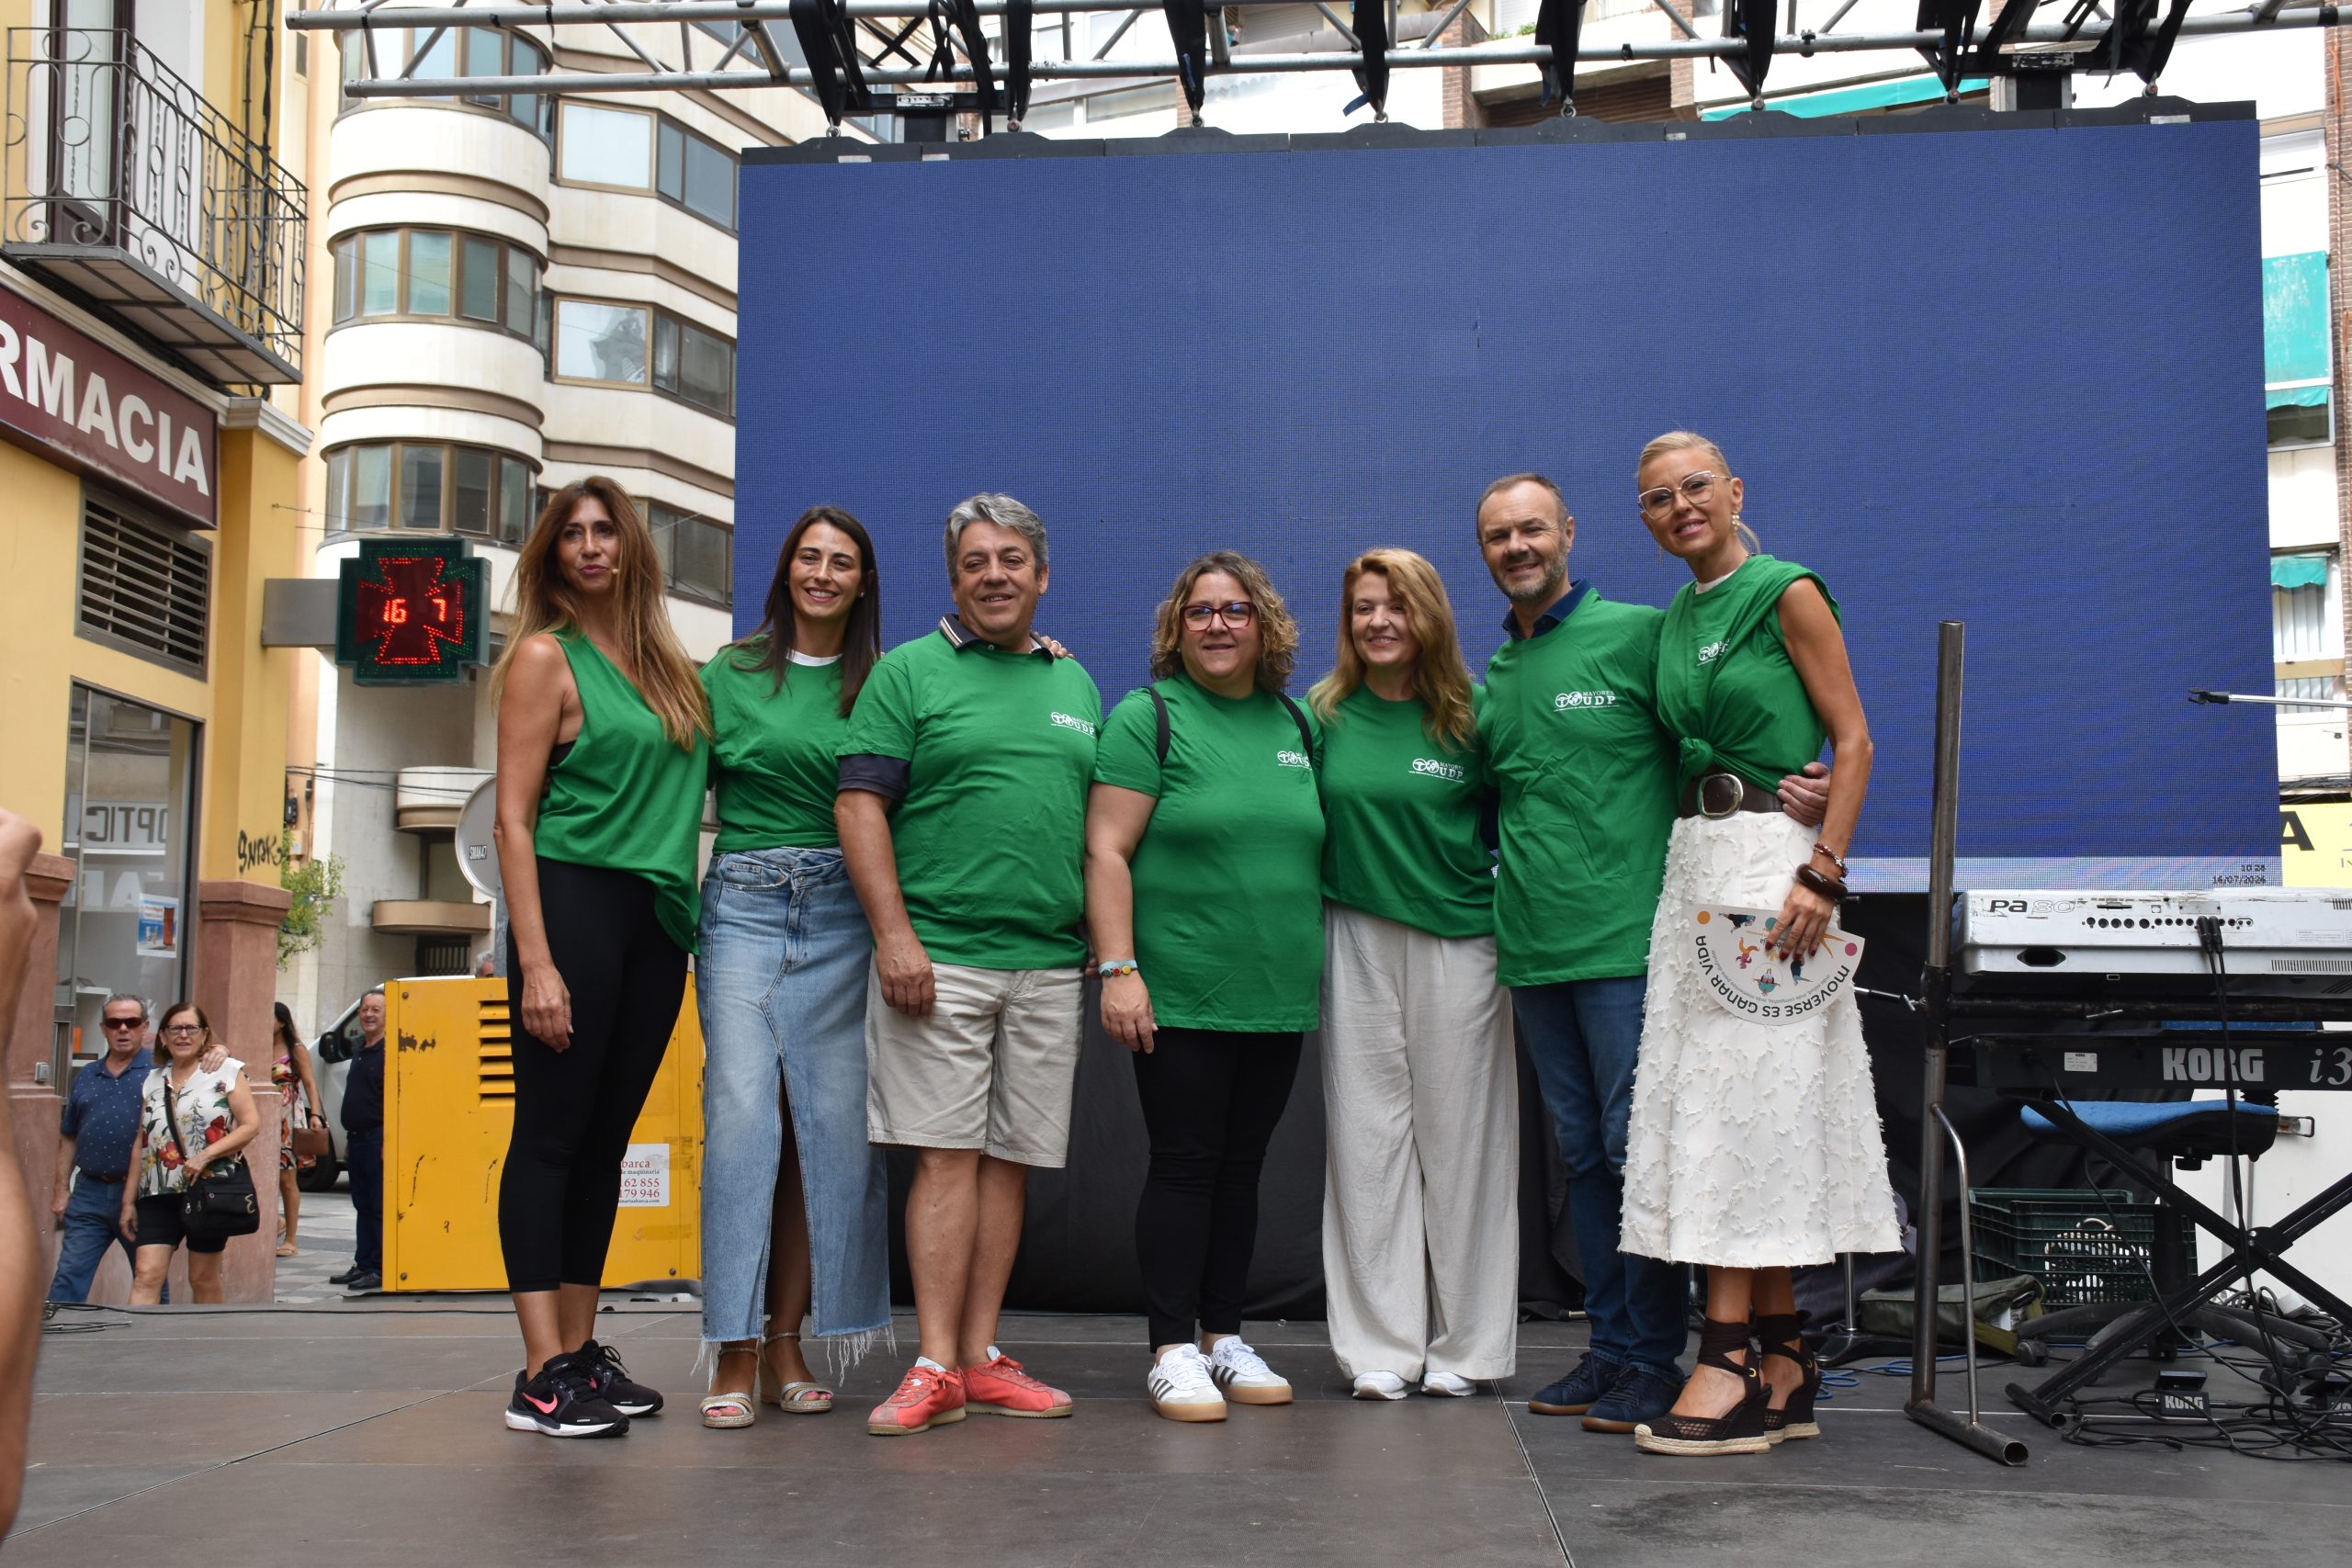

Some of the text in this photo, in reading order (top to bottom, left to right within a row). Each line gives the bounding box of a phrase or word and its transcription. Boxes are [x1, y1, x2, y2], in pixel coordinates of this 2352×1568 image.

[383, 598, 447, 624] 16 7
[1583, 695, 1615, 705] UDP
[1439, 767, 1464, 780] UDP
[1710, 975, 1758, 1014] GANAR
[1783, 964, 1850, 1018] MOVERSE
[1761, 1005, 1781, 1018] ES
[2162, 1047, 2265, 1082] KORG
[639, 1178, 660, 1188] 855
[639, 1188, 660, 1198] 946
